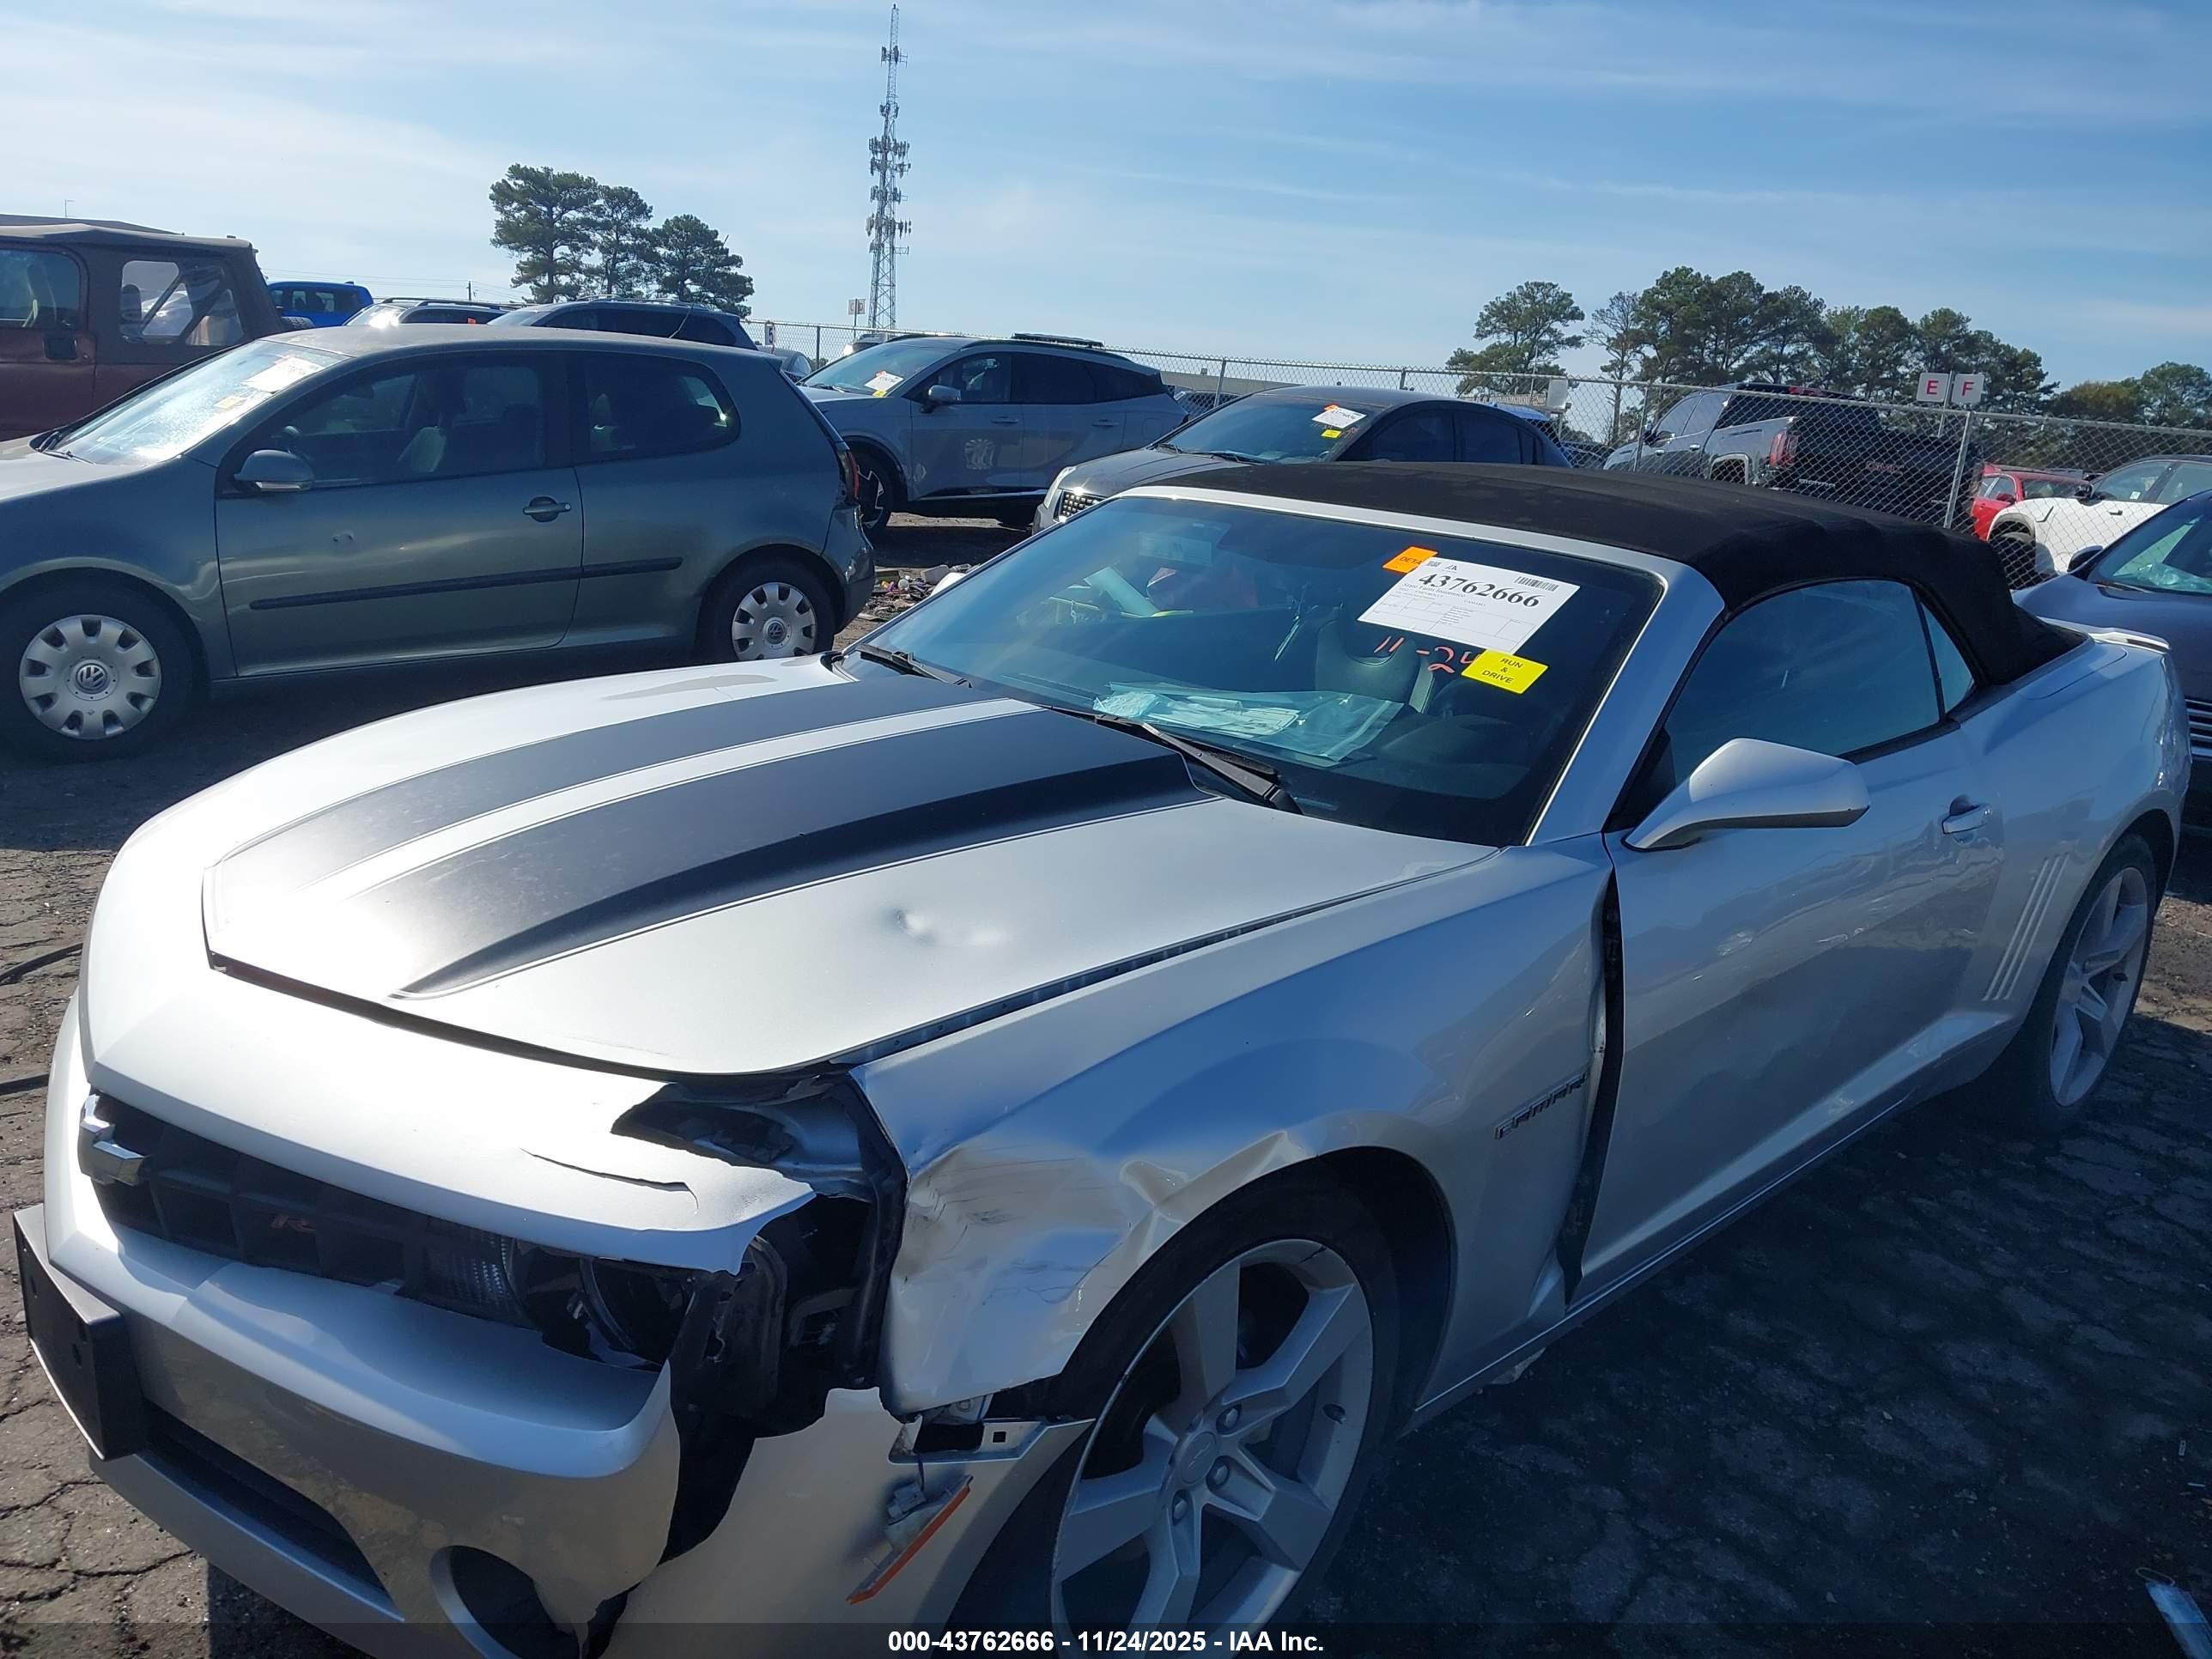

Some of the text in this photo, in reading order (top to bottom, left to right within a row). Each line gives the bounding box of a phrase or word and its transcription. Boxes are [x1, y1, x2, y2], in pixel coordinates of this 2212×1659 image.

[768, 327, 774, 343] 5
[1926, 380, 1939, 395] E
[1961, 381, 1975, 397] F
[1419, 573, 1547, 608] 43762666
[1499, 665, 1509, 674] &
[1500, 656, 1524, 669] RUN
[1481, 669, 1514, 684] DRIVE
